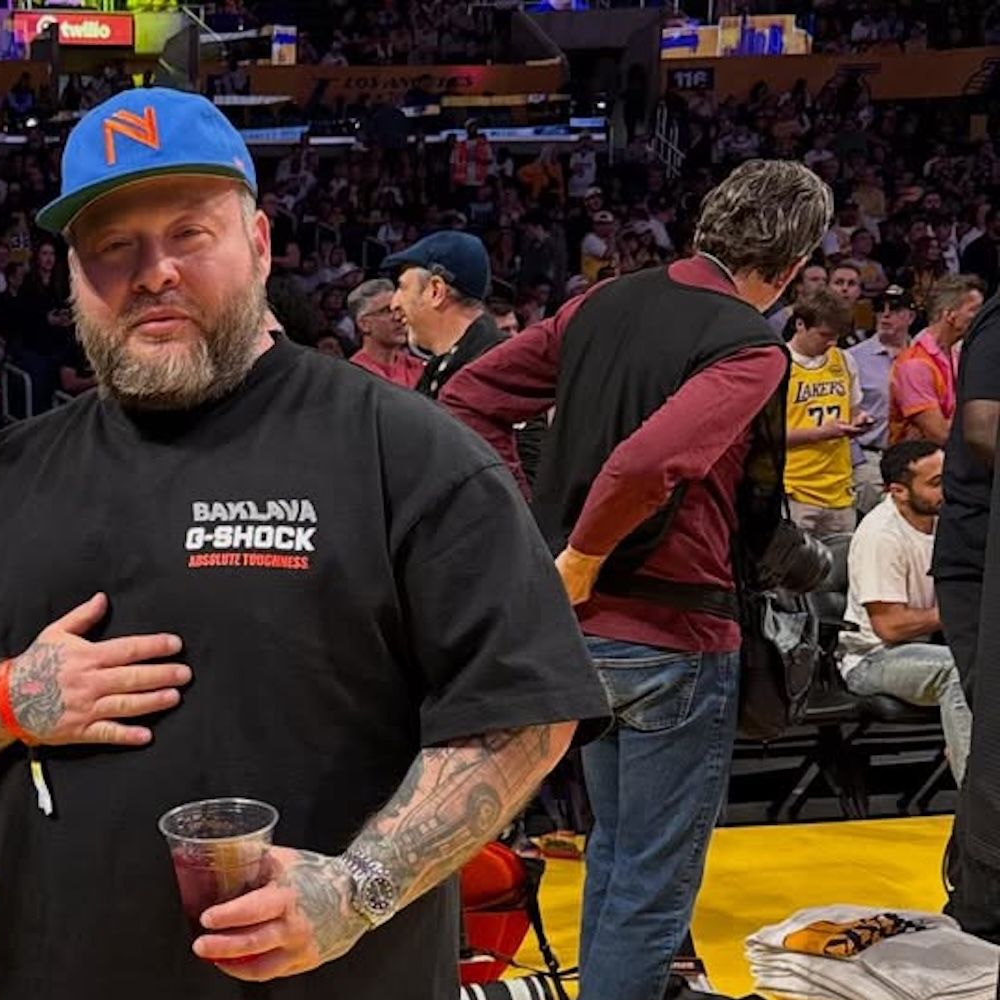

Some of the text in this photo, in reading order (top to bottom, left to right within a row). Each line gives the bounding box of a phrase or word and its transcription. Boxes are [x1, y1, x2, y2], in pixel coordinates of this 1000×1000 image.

[794, 381, 847, 404] LAKERS
[192, 498, 318, 524] BAKLAVA
[184, 524, 317, 552] G-SHOCK
[187, 553, 310, 570] ABSOLUTE TOUGHNESS
